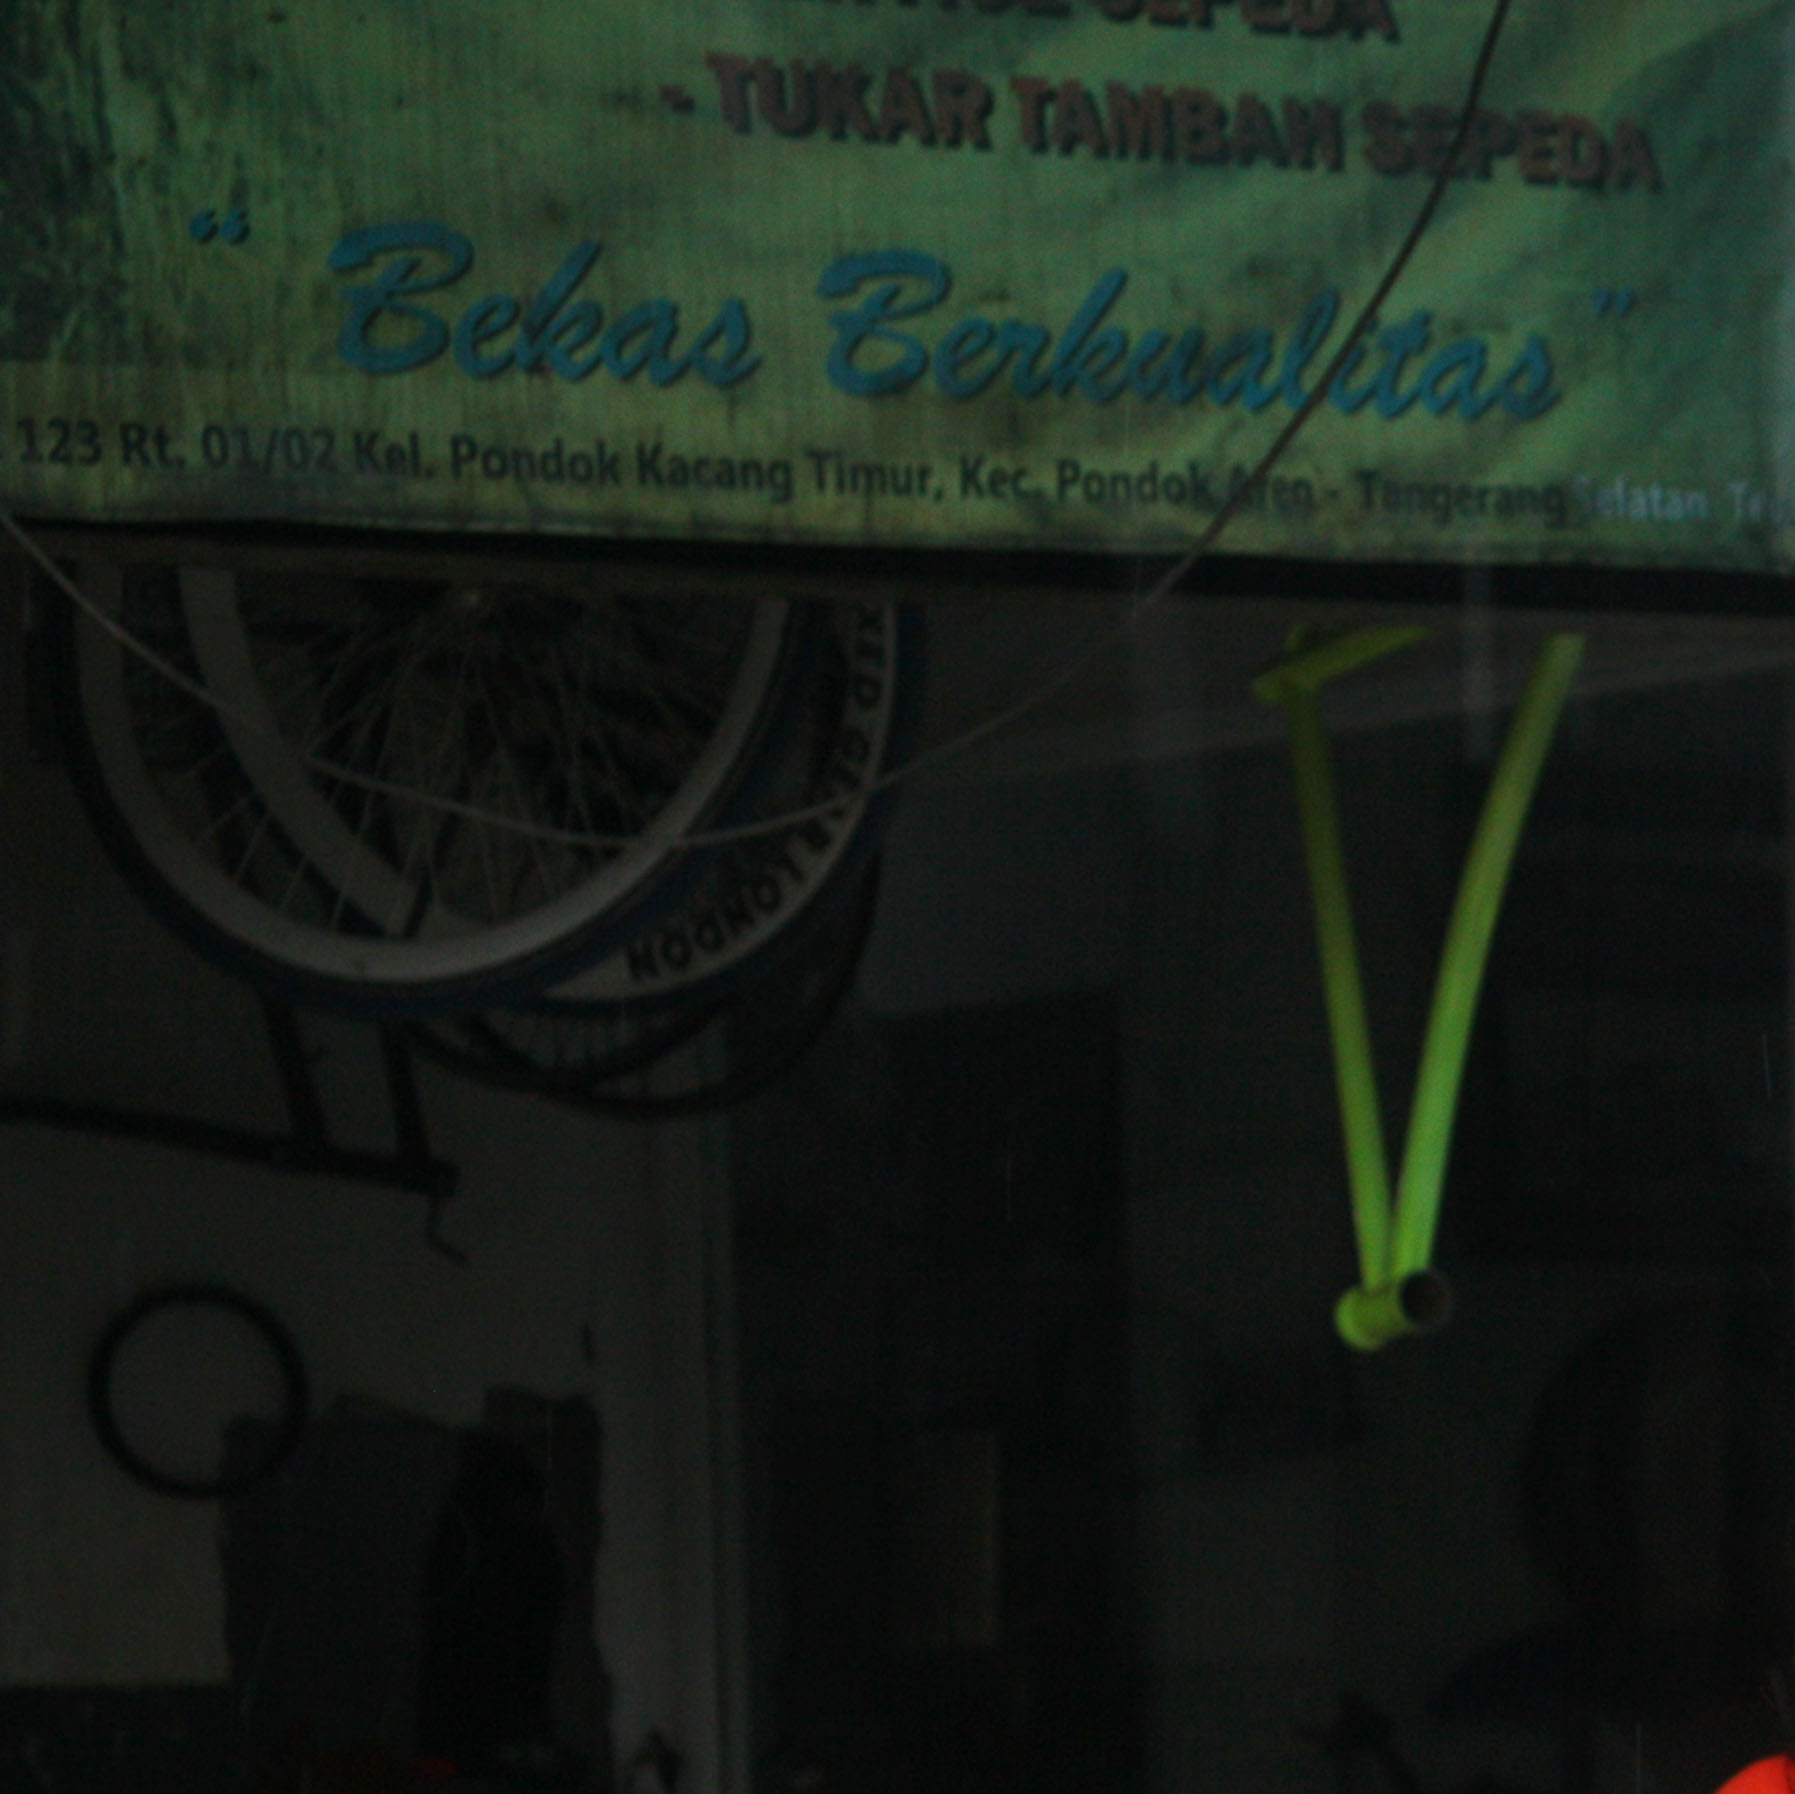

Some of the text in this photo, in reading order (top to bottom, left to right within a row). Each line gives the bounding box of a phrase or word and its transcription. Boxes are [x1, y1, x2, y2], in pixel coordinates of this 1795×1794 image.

[706, 51, 994, 151] TUKAR
[1359, 99, 1666, 194] SEPEDA
[326, 220, 763, 388] Bekas
[815, 247, 1563, 423] Berkualitas
[14, 416, 104, 466] 123
[118, 422, 188, 469] Rt.
[201, 424, 339, 475] 01/02
[353, 430, 435, 479] Kel.
[448, 433, 621, 486] Pondok
[636, 441, 795, 505] Kacang
[803, 447, 944, 503] Timur,
[959, 456, 1046, 502] Kec.
[1056, 457, 1211, 507] Pondok
[1353, 468, 1569, 529] Tangerang
[1572, 474, 1708, 522] Selatan
